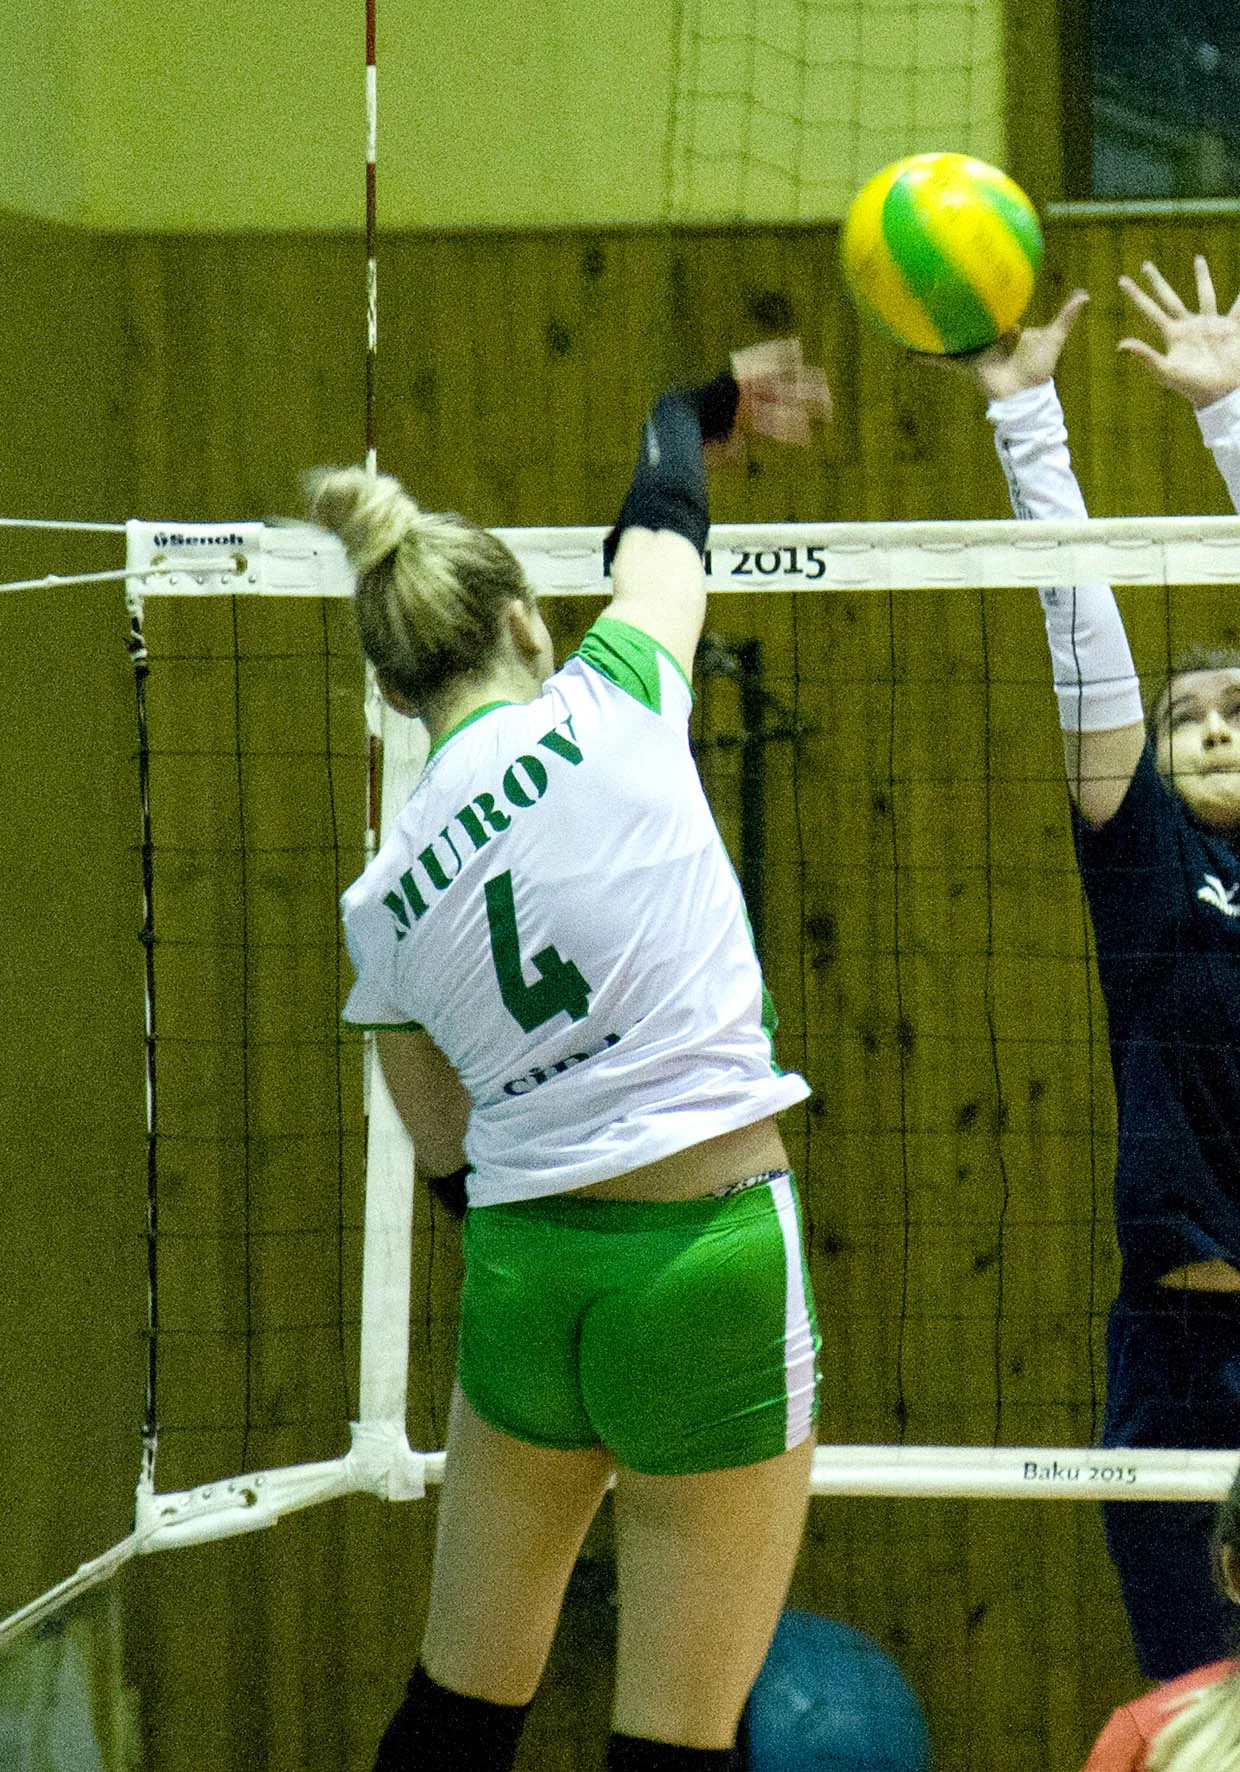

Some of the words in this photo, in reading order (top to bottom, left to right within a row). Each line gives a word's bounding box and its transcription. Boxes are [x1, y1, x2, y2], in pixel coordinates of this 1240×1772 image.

[730, 547, 826, 579] 2015
[382, 714, 585, 942] MUROV
[483, 868, 593, 1034] 4
[1023, 1461, 1081, 1481] Baku
[1088, 1467, 1137, 1484] 2015
